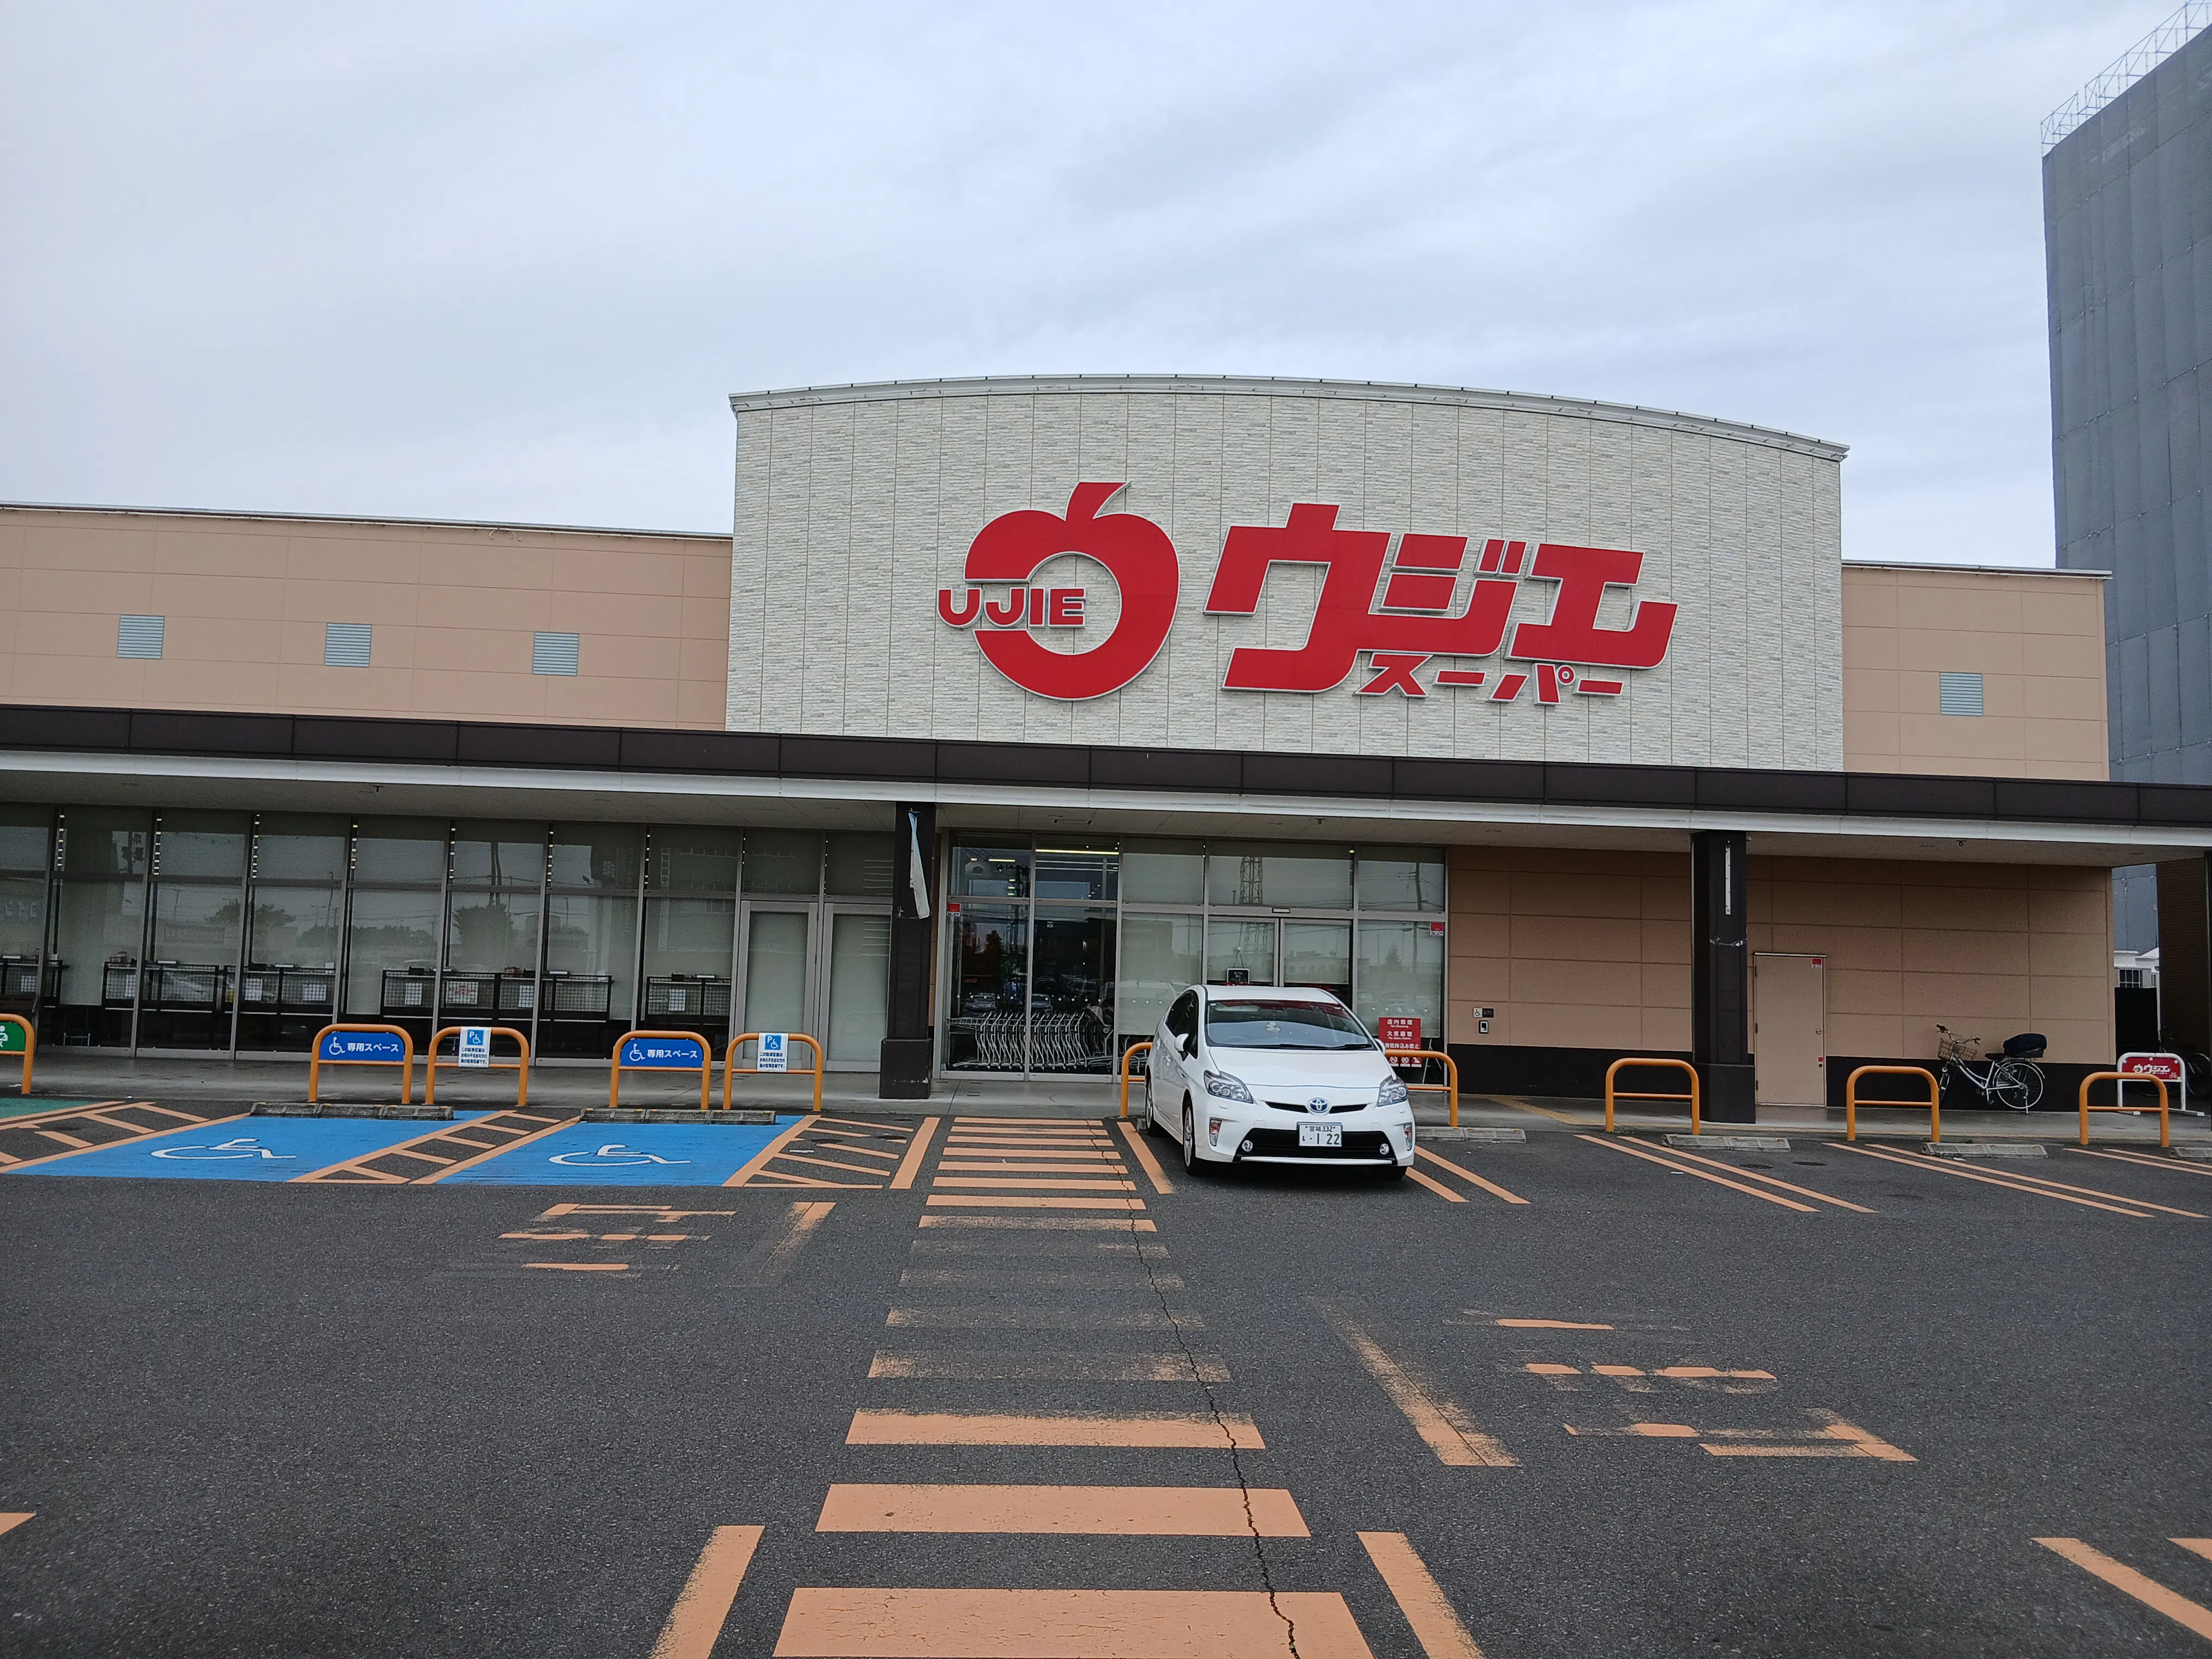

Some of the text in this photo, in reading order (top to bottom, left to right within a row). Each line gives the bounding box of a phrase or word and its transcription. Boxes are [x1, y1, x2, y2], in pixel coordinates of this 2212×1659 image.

[937, 587, 1086, 628] UJIE
[1204, 502, 1679, 693] ウジエ
[1354, 653, 1624, 705] スーパー
[347, 1042, 399, 1053] 専用スペース
[647, 1049, 698, 1058] 専用スペース
